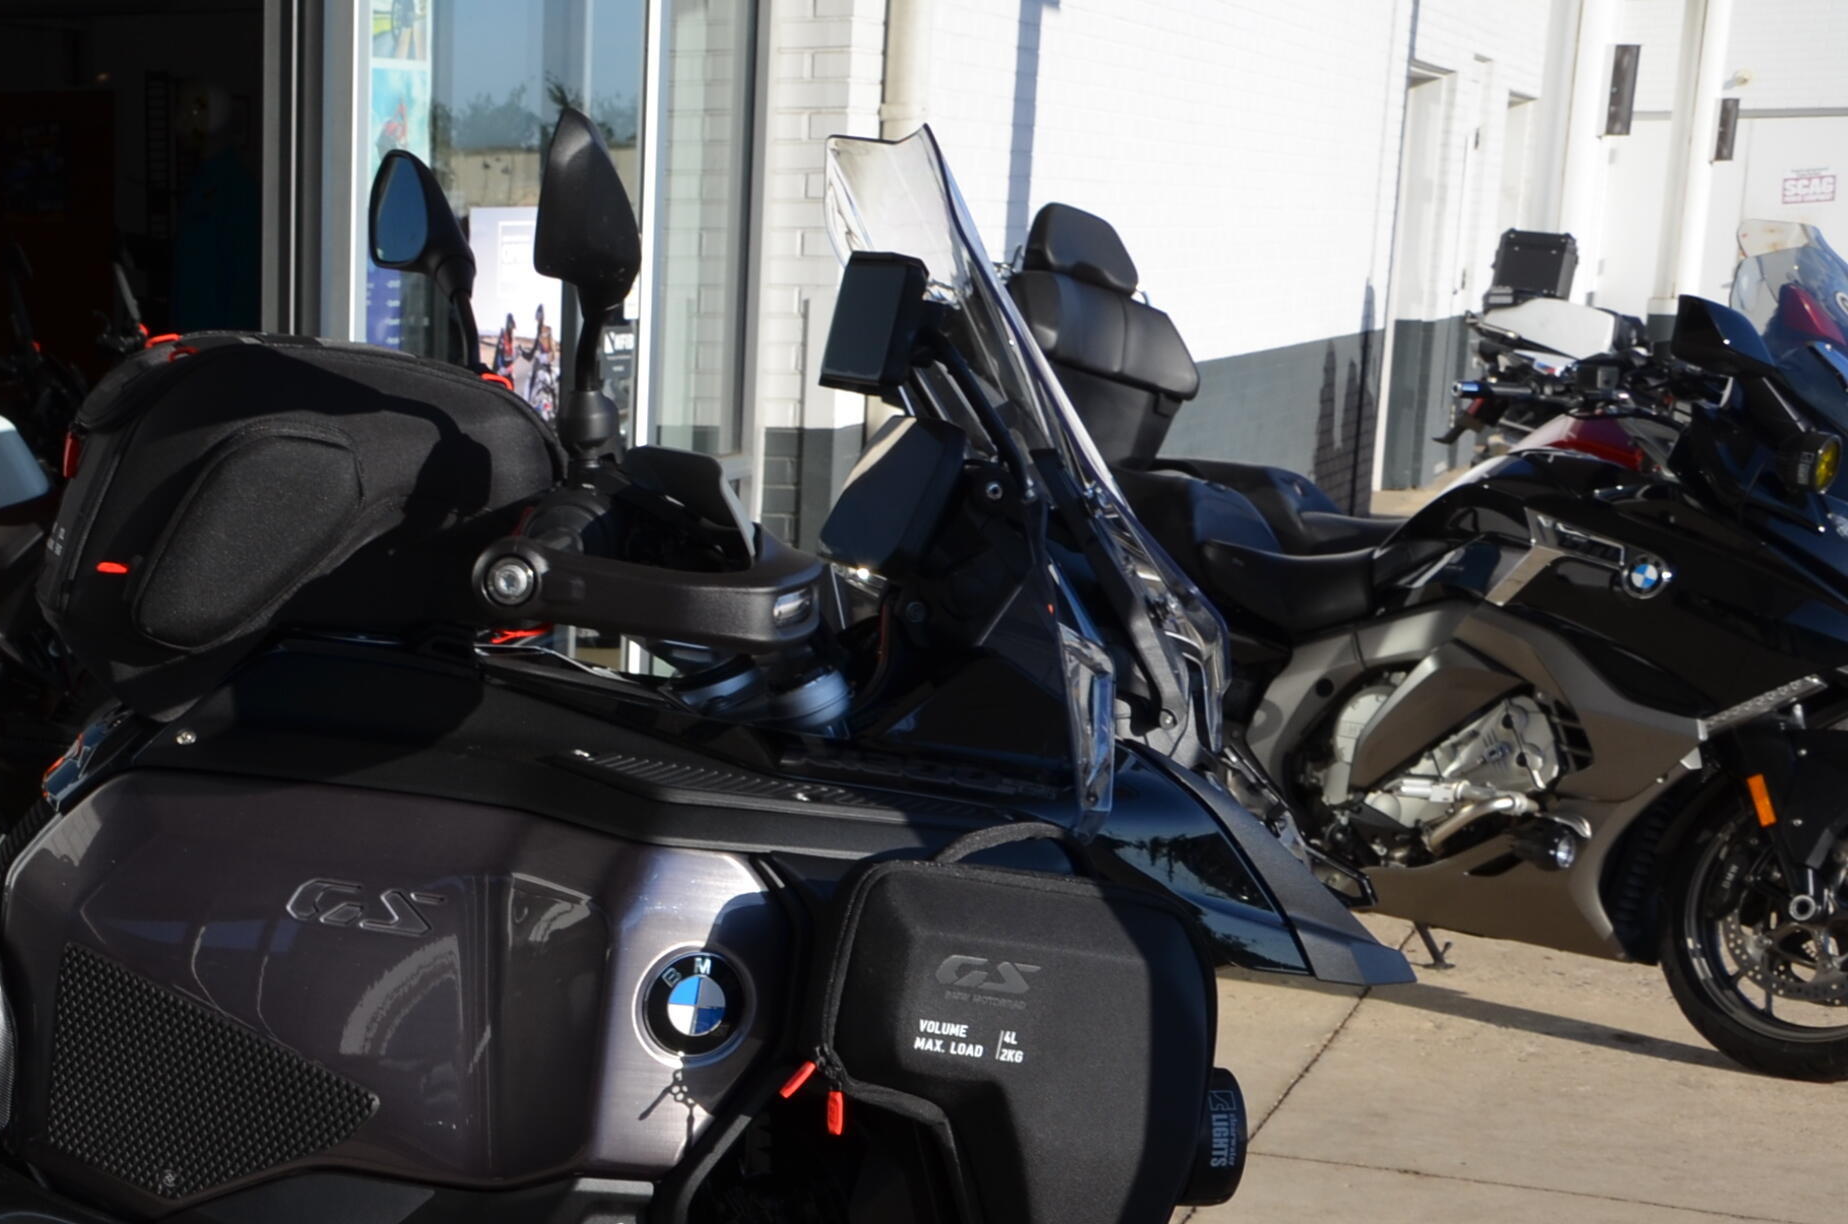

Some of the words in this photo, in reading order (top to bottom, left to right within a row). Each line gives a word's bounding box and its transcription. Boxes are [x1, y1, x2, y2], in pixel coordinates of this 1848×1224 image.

[918, 1018, 969, 1039] VOLUME
[1003, 1030, 1019, 1046] 4L
[913, 1036, 946, 1054] MAX.
[949, 1041, 984, 1059] LOAD
[999, 1049, 1025, 1064] 2KG
[1210, 1113, 1229, 1168] LIGHTS
